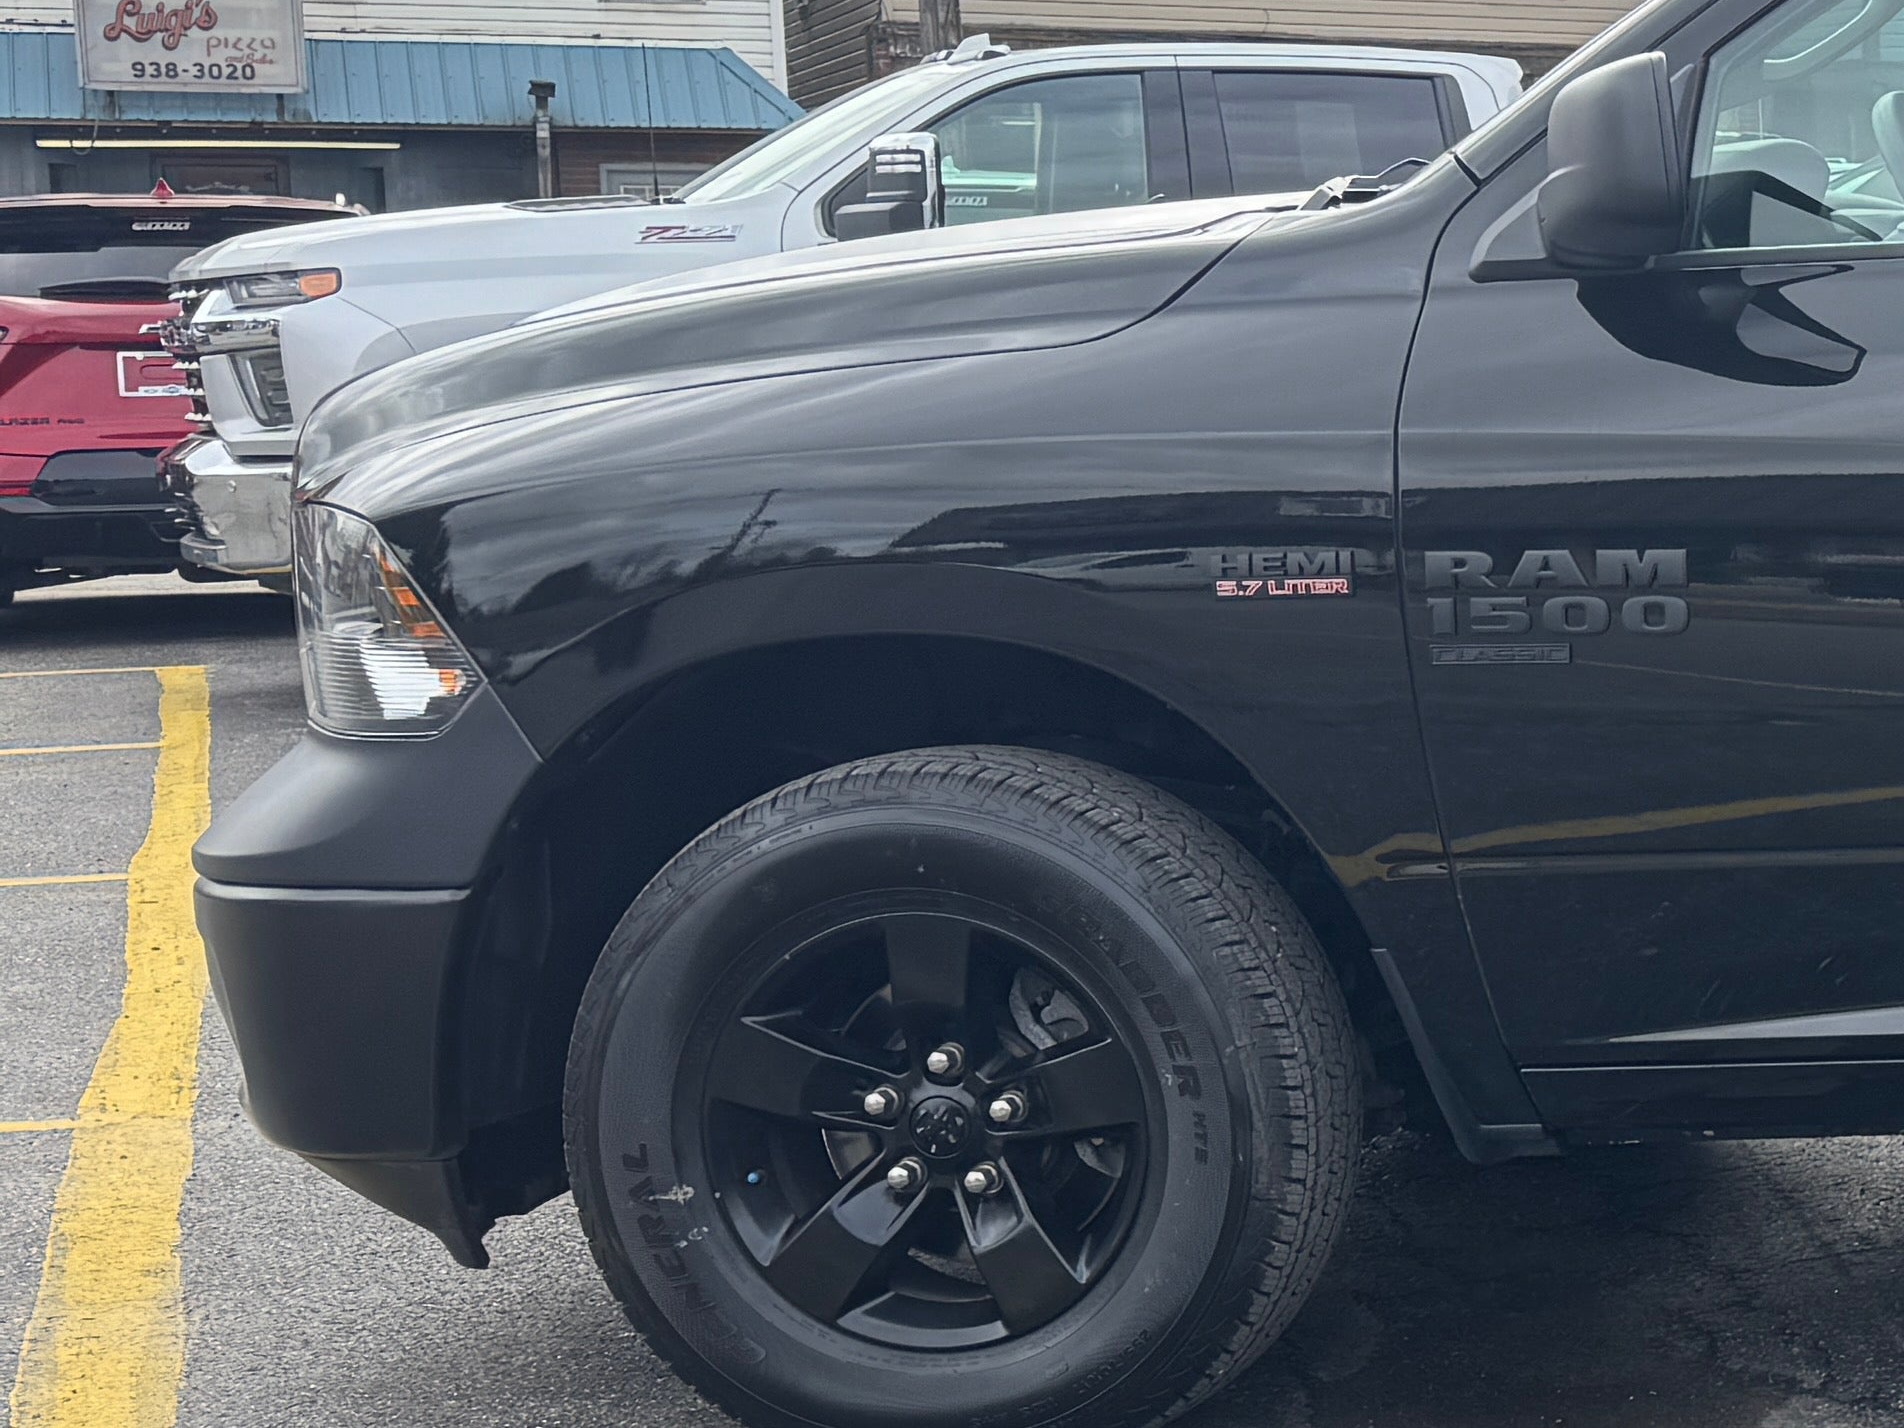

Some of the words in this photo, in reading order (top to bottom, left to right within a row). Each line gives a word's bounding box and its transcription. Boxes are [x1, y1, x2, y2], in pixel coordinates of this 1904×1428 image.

[131, 61, 256, 81] 938-3020
[1211, 550, 1355, 577] HEMI
[1424, 548, 1688, 589] RAM
[1215, 579, 1263, 597] 5.7
[1267, 578, 1350, 596] LITER
[1427, 595, 1690, 636] 1500
